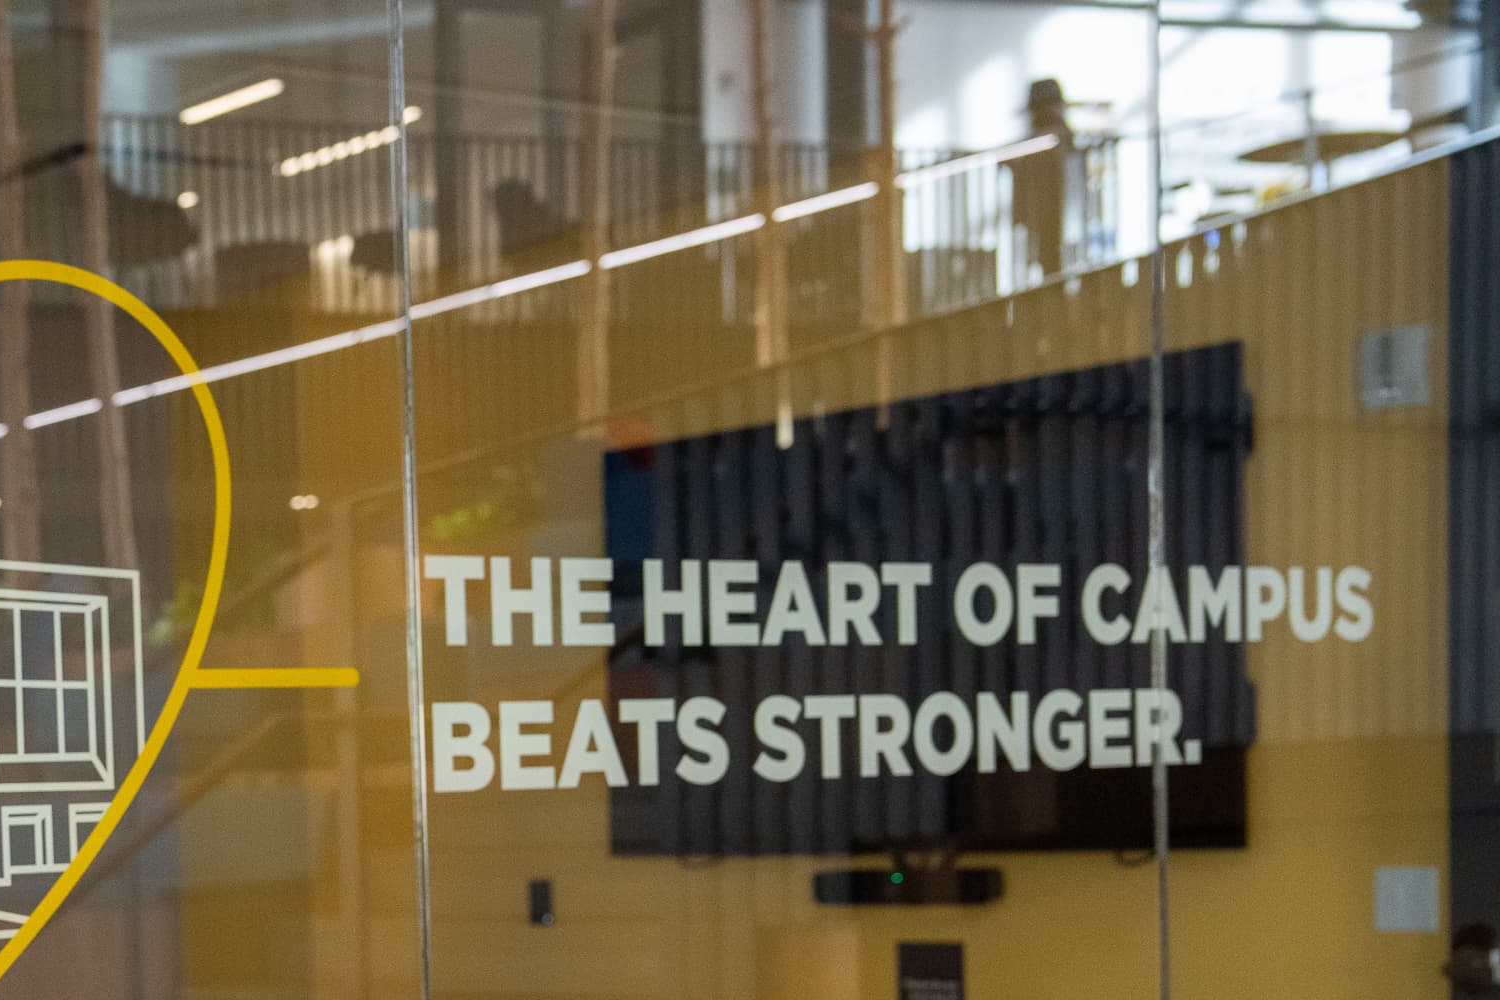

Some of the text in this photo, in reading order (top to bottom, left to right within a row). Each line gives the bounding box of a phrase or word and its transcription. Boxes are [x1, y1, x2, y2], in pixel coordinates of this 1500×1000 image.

[424, 556, 1374, 646] THE HEART OF CAMPUS
[432, 689, 1201, 793] BEATS STRONGER.
